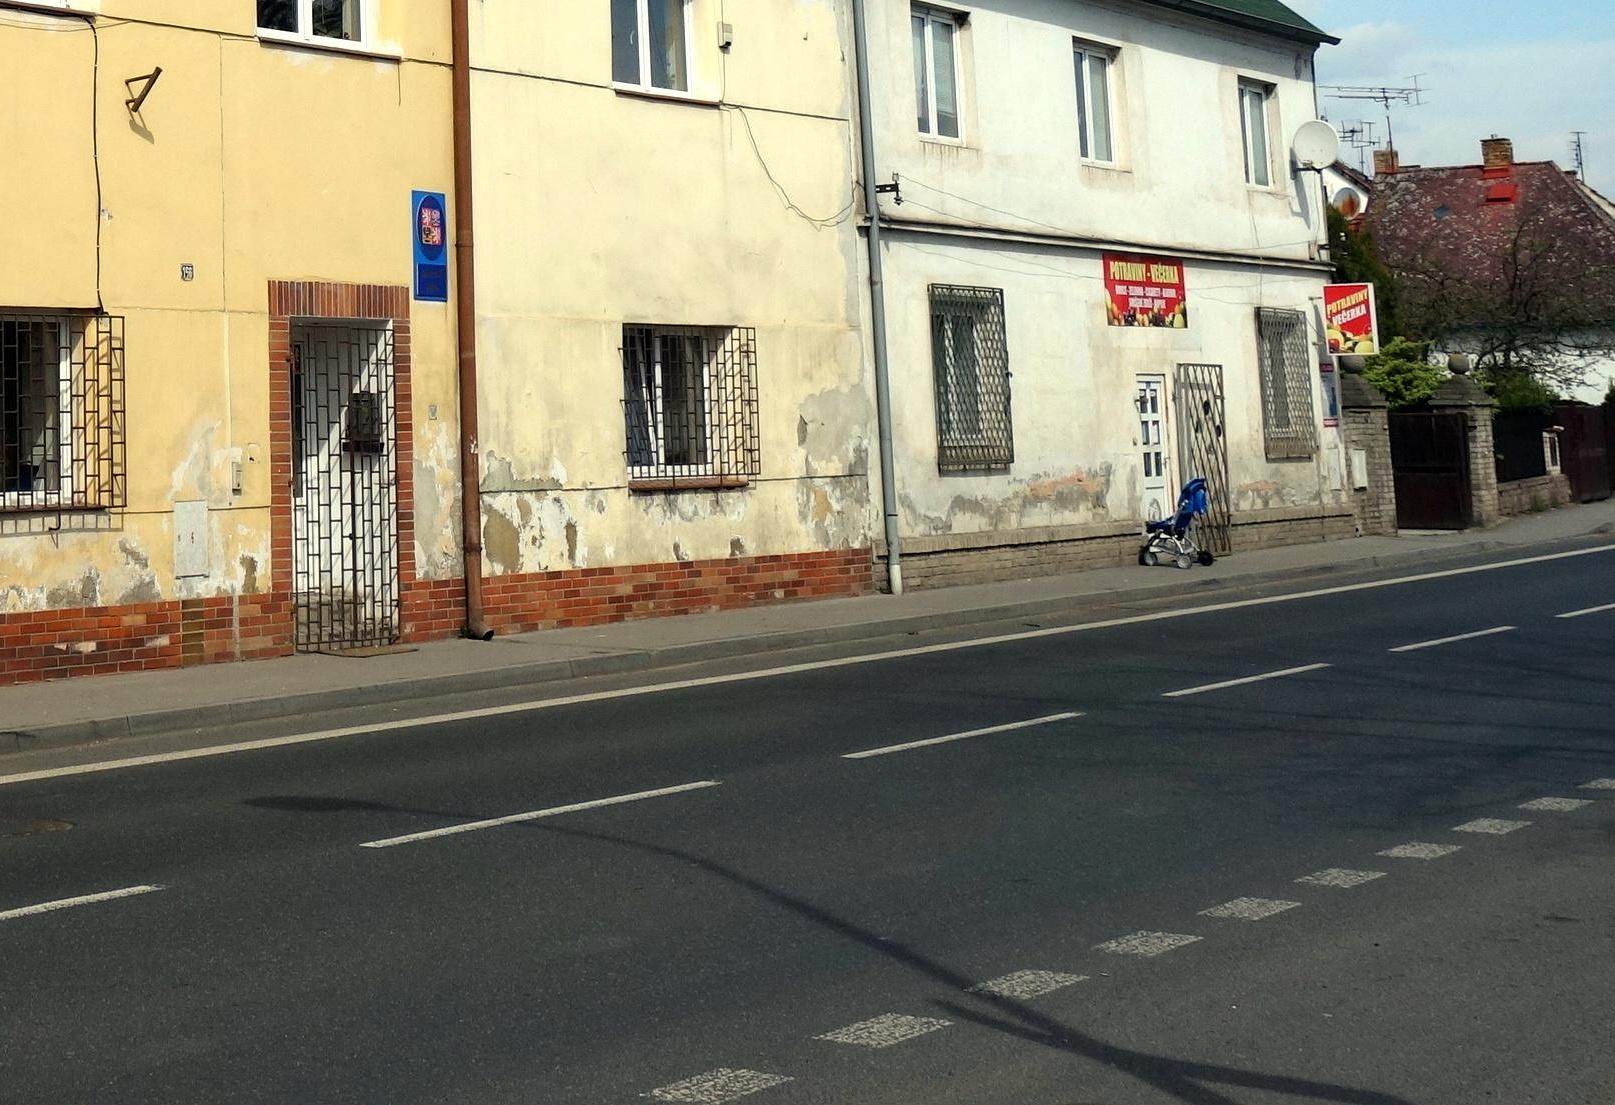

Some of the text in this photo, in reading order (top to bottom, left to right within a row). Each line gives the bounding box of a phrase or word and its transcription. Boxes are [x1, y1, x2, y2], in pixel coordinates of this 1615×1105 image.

[1109, 261, 1147, 282] POTRAVINY
[1150, 261, 1180, 285] VEČERKA
[1326, 287, 1368, 317] POTRAVINY
[1332, 303, 1367, 326] VEČERKA
